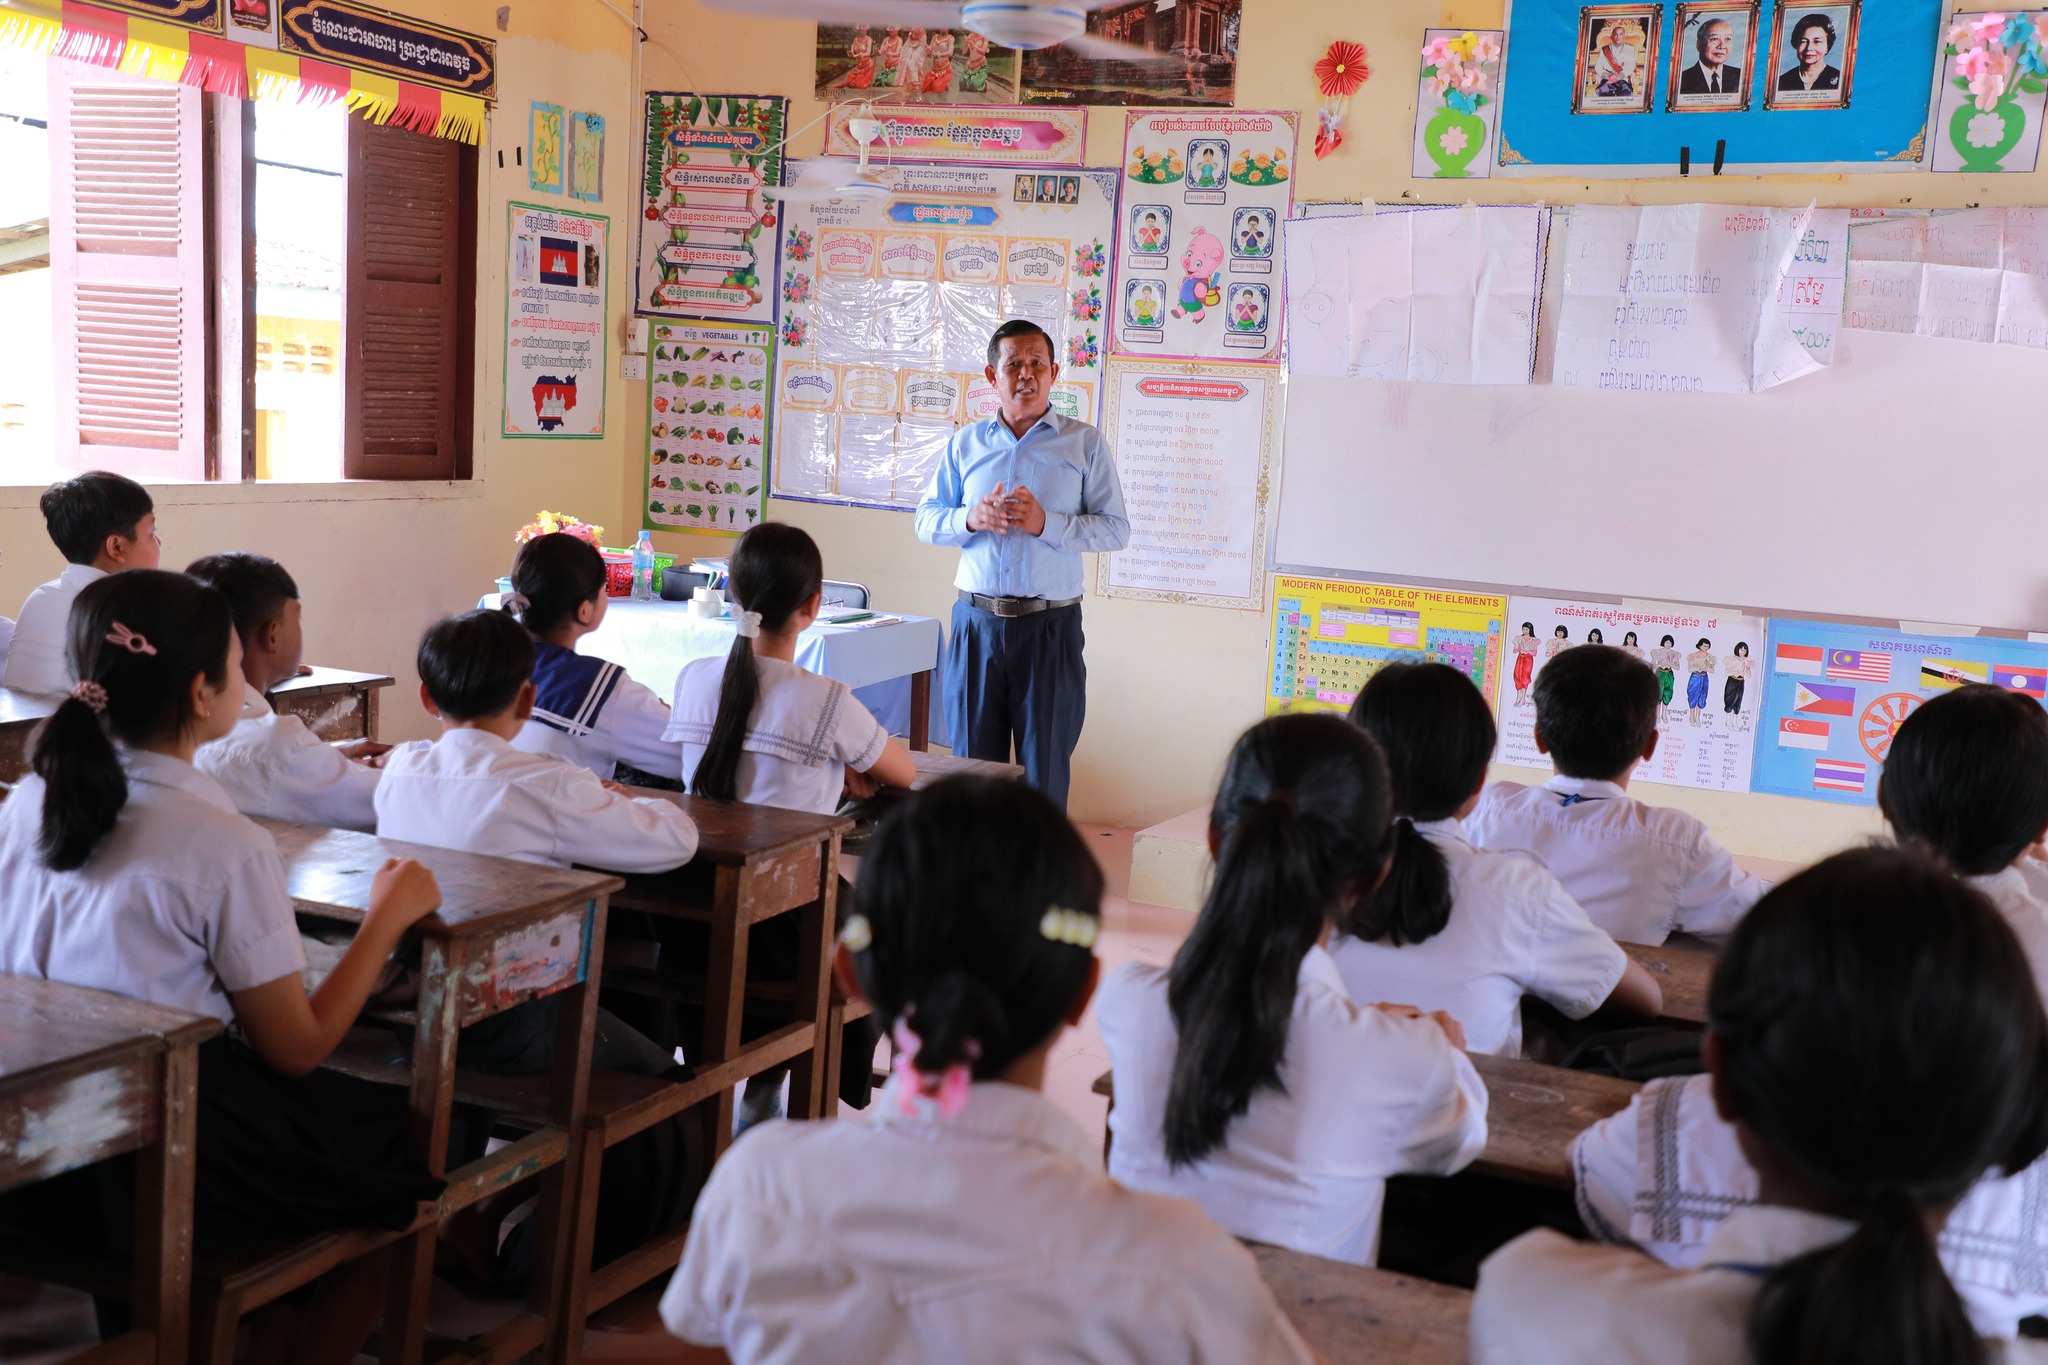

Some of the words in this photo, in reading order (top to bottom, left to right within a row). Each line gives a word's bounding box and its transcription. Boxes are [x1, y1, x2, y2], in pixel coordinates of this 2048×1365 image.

[701, 332, 739, 341] VEGETABLES
[1281, 579, 1323, 591] MODERN
[1325, 583, 1370, 596] PERIODIC
[1374, 588, 1404, 599] TABLE
[1407, 591, 1420, 600] OF
[1423, 592, 1443, 602] THE
[1445, 594, 1499, 608] ELEMENTS
[1360, 596, 1385, 606] LONG
[1388, 599, 1415, 608] FORM
[1868, 640, 1953, 656] សមាគមអាស៊ាន
